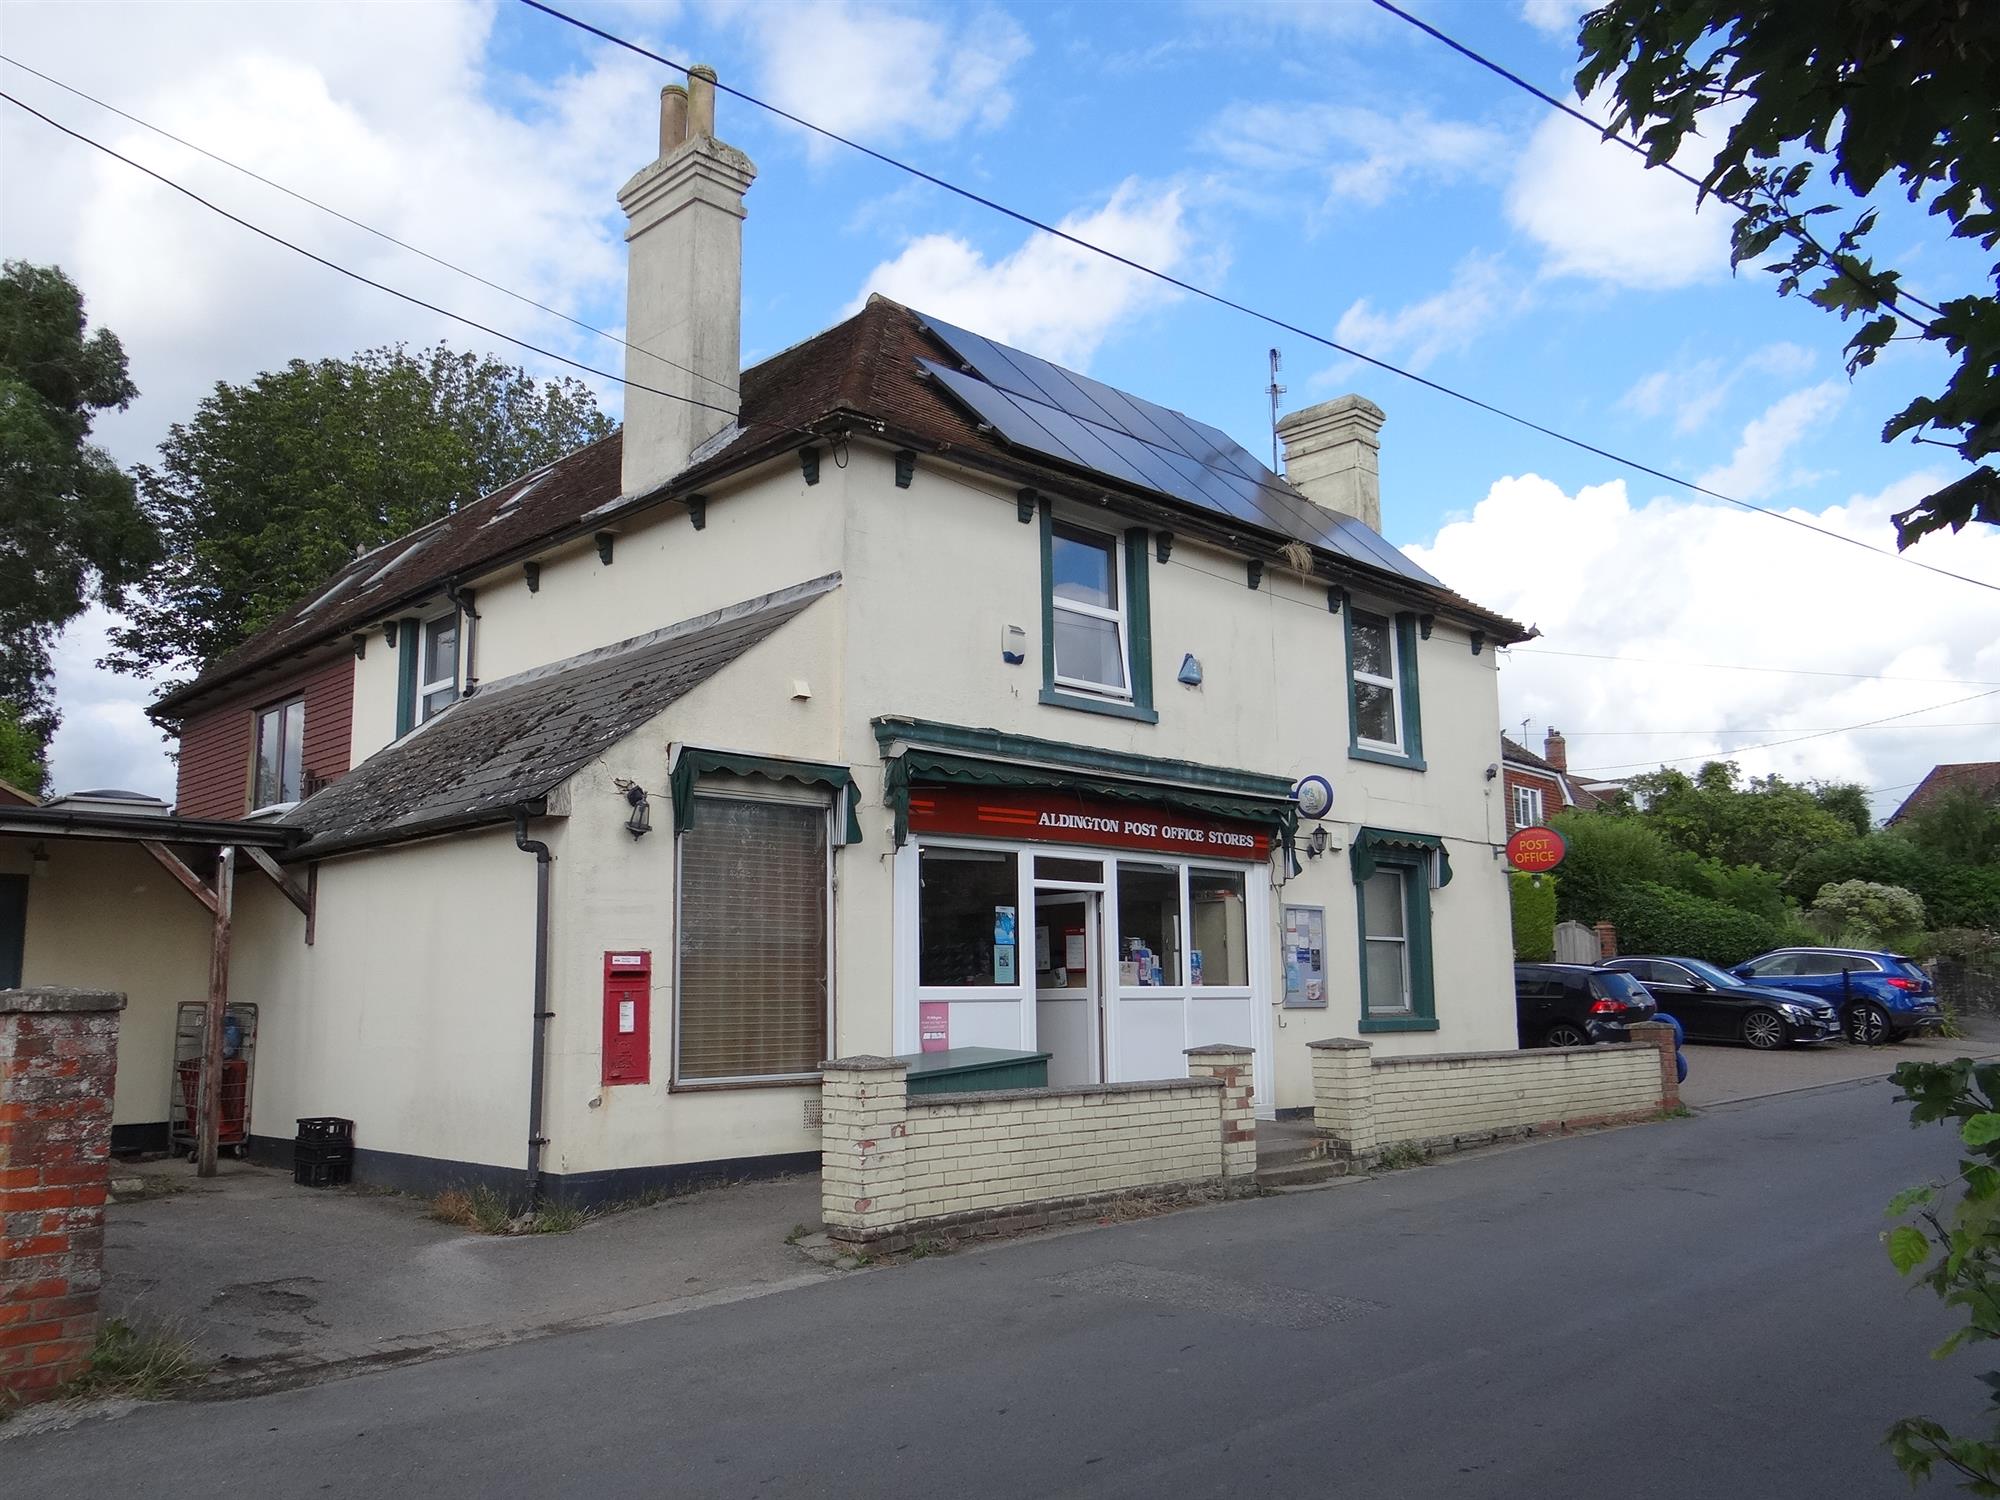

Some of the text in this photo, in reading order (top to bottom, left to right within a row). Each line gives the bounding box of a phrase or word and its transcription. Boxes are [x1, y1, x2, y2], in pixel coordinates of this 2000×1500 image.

[1039, 812, 1254, 847] ALDINGTON POST OFFICE STORES
[1520, 839, 1550, 850] POST
[1515, 851, 1555, 863] OFFICE
